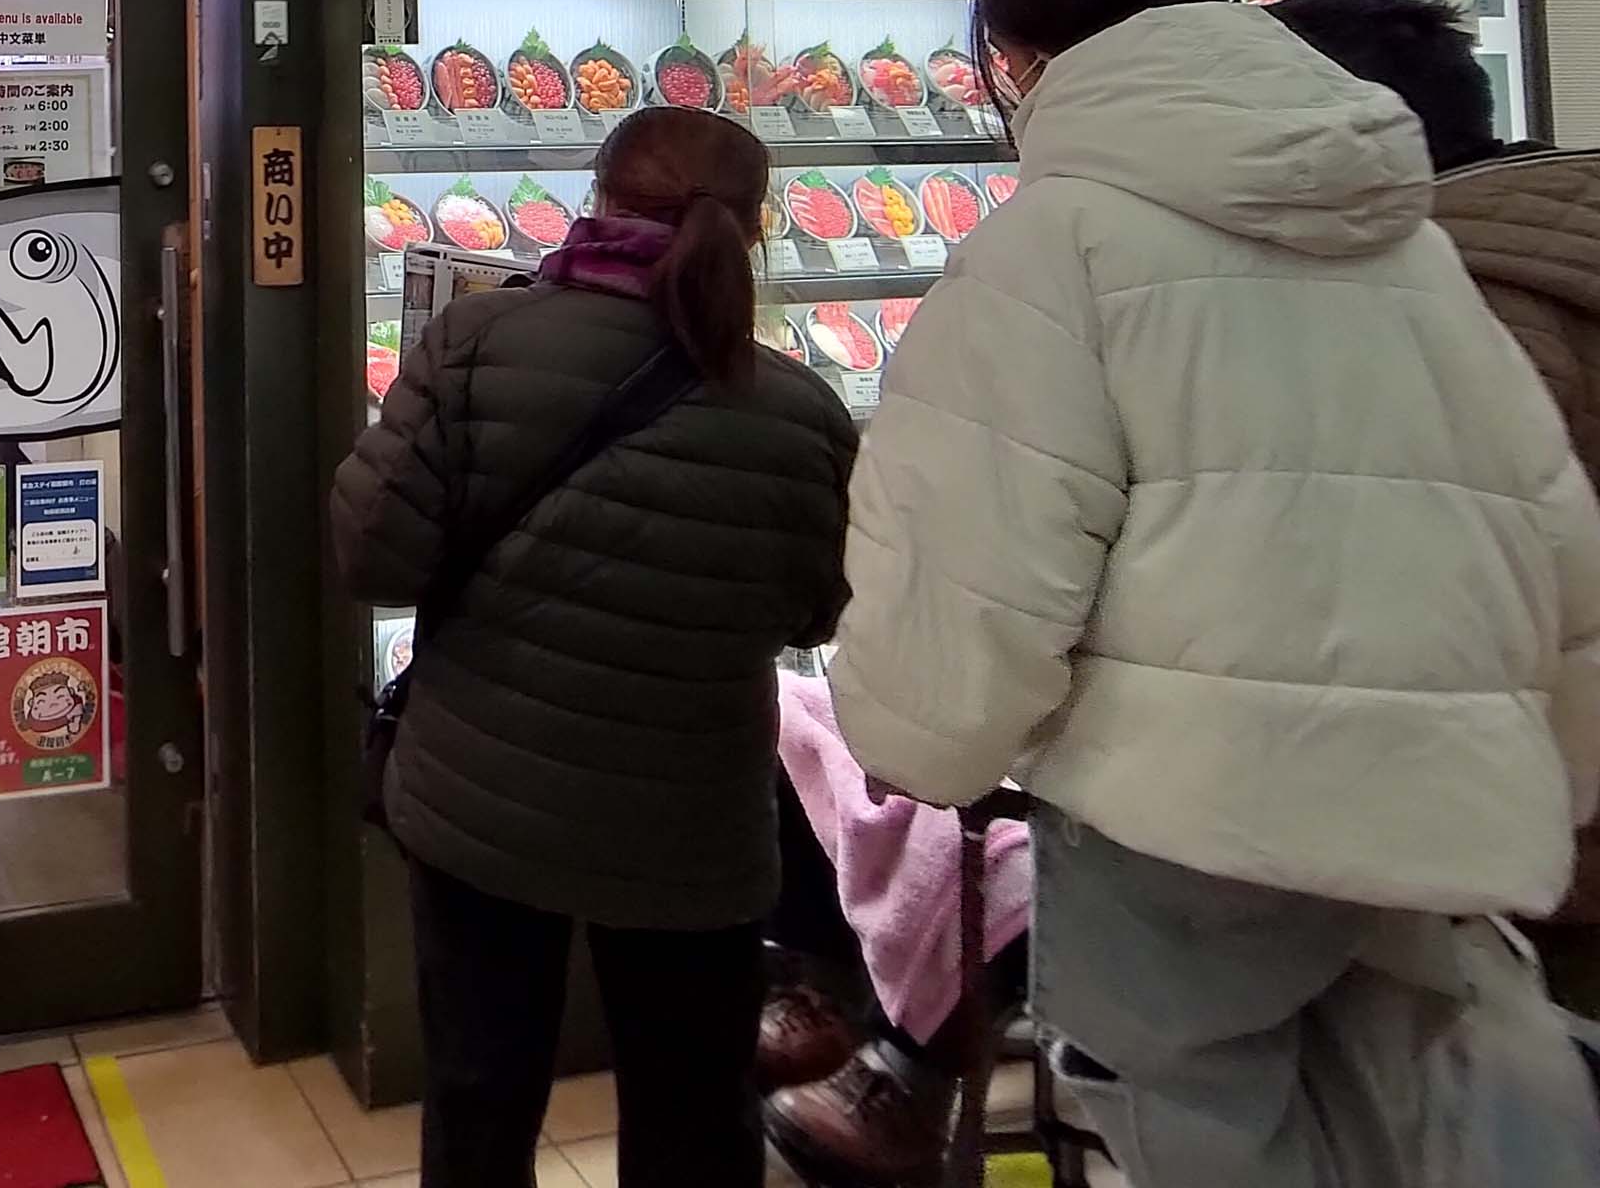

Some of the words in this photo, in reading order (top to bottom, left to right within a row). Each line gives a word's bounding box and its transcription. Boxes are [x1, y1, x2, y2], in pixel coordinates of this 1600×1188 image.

[35, 13, 83, 25] available
[38, 100, 68, 112] 6:00
[39, 120, 69, 132] 2:00
[39, 140, 69, 152] 2:30
[262, 148, 295, 269] 商い中
